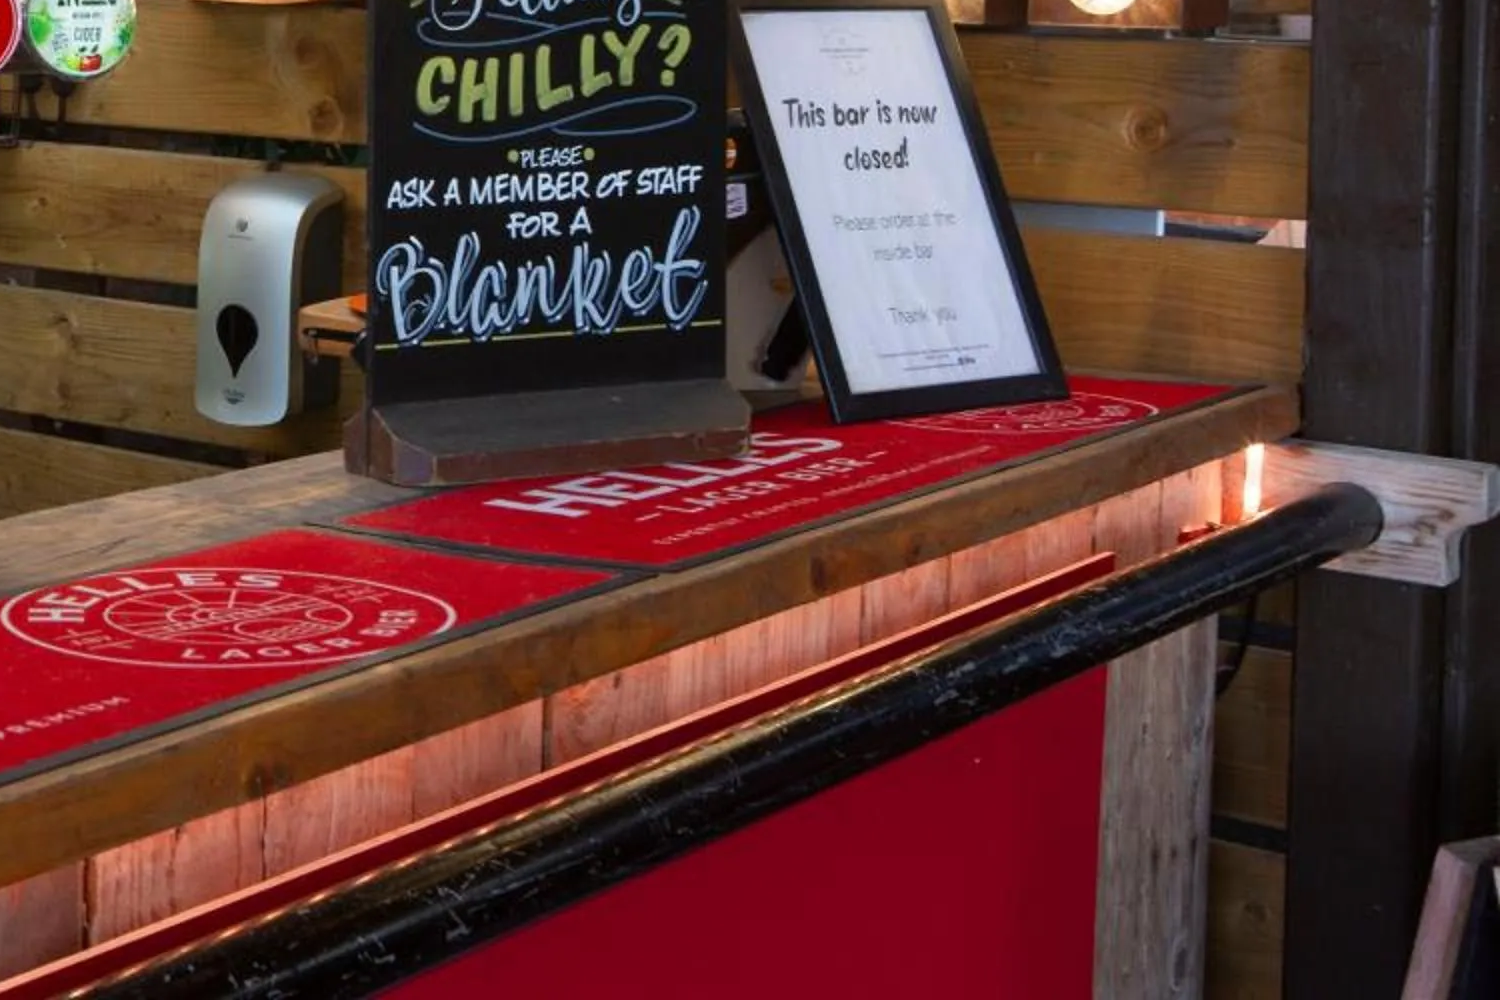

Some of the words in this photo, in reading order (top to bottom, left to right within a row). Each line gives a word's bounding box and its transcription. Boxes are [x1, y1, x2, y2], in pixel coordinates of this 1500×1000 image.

[416, 23, 692, 123] CHILLY?
[782, 98, 826, 129] This
[832, 102, 869, 127] bar
[876, 99, 892, 124] is
[898, 103, 938, 125] now
[519, 146, 583, 169] PLEASE
[844, 137, 910, 171] closed!
[387, 177, 436, 209] ASK
[443, 177, 462, 205] A
[469, 171, 590, 205] MEMBER
[596, 169, 633, 198] OF
[636, 165, 704, 195] STAFF
[507, 211, 562, 240] FOR
[569, 206, 593, 236] A
[375, 204, 709, 345] Blanket
[887, 306, 928, 325] Thank
[483, 431, 844, 519] HELLES
[655, 480, 793, 514] LAGER
[27, 571, 284, 624] HELLES
[180, 636, 364, 661] LAGER
